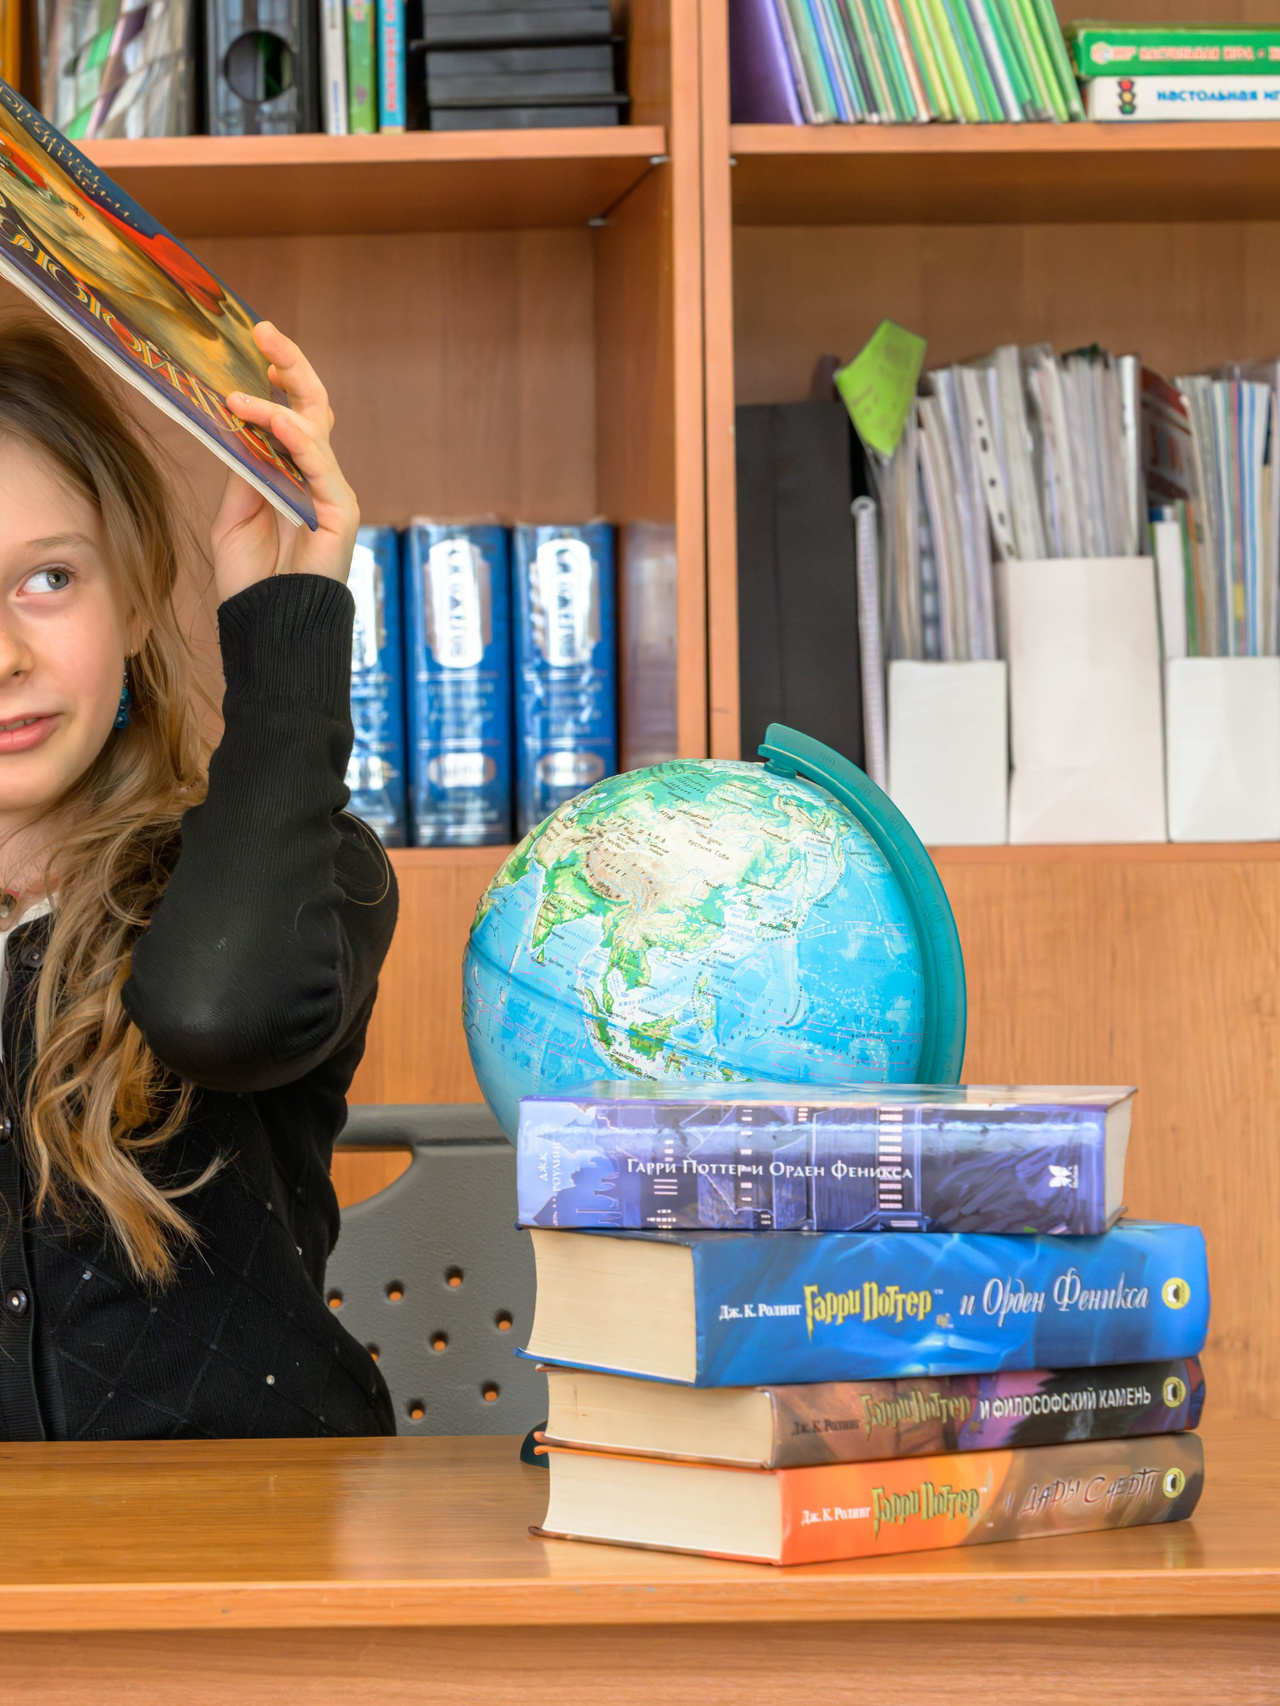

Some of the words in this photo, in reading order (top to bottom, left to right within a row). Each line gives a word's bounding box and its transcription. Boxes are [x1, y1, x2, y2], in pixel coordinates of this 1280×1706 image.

[757, 1303, 802, 1318] Ролинг
[803, 1284, 861, 1343] Гарри
[862, 1281, 933, 1324] Поттер
[982, 1275, 1046, 1328] Орден
[1053, 1266, 1150, 1312] Феникса
[992, 1385, 1097, 1420] ФИЛОСОФСКИЙ
[1098, 1385, 1152, 1409] КАМЕНЬ
[834, 1506, 871, 1521] Ролинг
[871, 1486, 920, 1542] Гарри
[921, 1481, 981, 1522] Поттер
